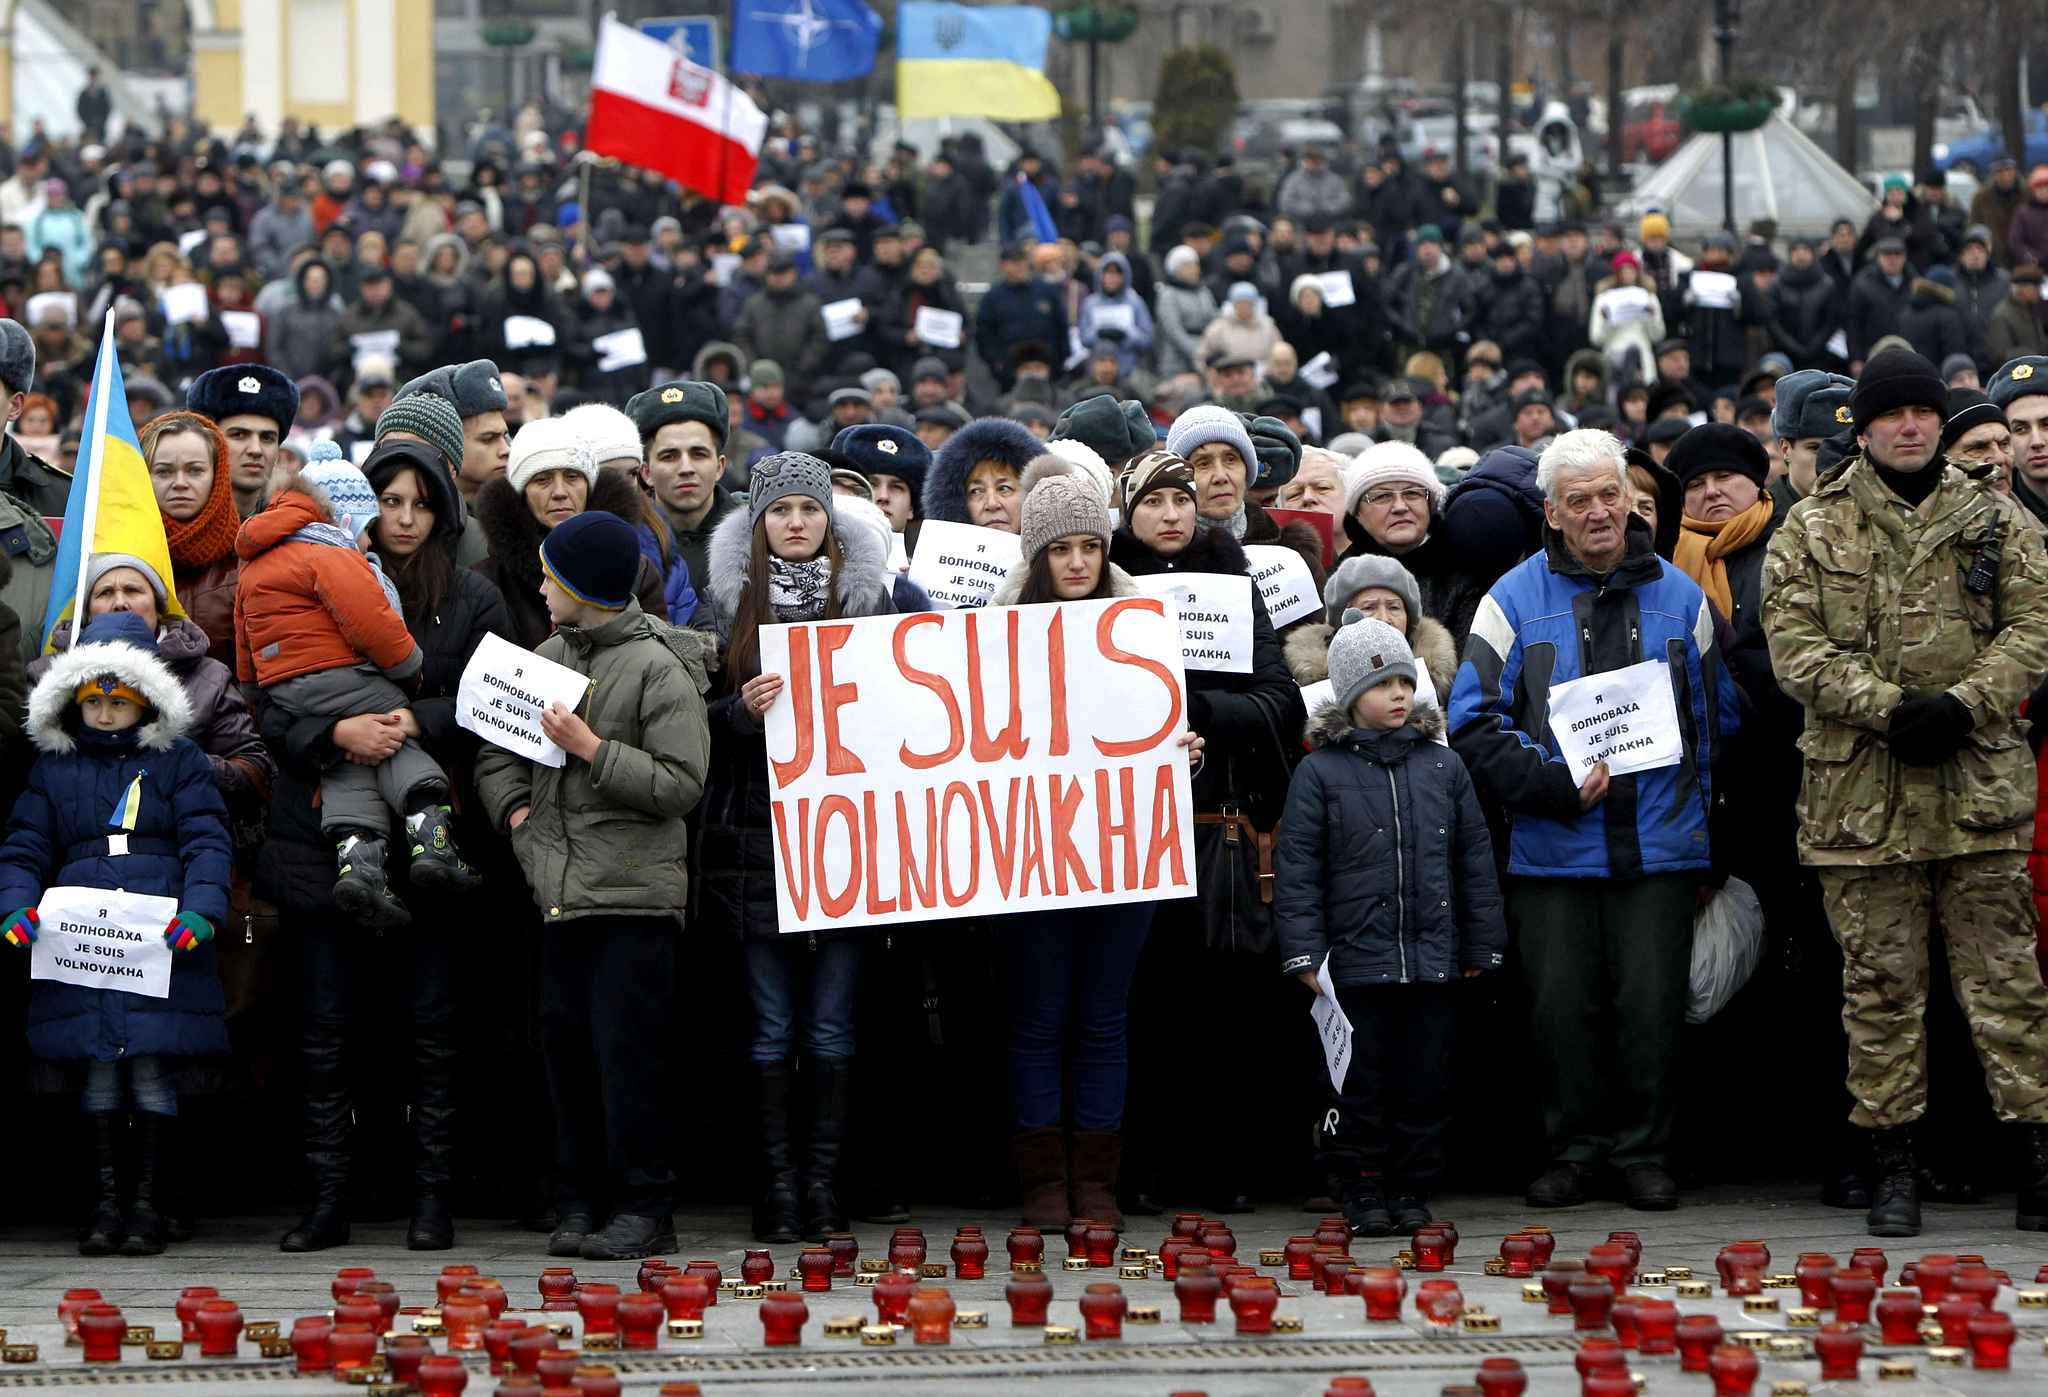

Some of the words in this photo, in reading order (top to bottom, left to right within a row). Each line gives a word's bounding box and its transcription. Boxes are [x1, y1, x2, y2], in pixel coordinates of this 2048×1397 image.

[977, 545, 985, 553] Я
[939, 555, 1008, 578] ВОЛНОВАХ
[950, 576, 964, 586] JE
[968, 578, 995, 593] SUIS
[1261, 584, 1280, 598] UIS
[1188, 594, 1196, 603] Я
[1179, 611, 1229, 623] НОВАХА
[1186, 630, 1214, 640] SUIS
[1182, 648, 1231, 660] OVAKHA
[514, 668, 523, 678] Я
[483, 673, 545, 709] ВОЛНОВАХА
[770, 624, 866, 789] JE
[892, 598, 1182, 769] SUIS
[1595, 694, 1603, 704] Я
[489, 697, 502, 709] JE
[506, 703, 531, 721] SUIS
[1571, 702, 1640, 732] ВОЛНОВАХА
[472, 707, 542, 746] VOLNOVAKHA
[1588, 733, 1602, 745] JE
[1604, 723, 1629, 739] SUIS
[772, 764, 1189, 921] VOLNOVAKHA
[98, 908, 107, 918] Я
[60, 922, 143, 943] ВОЛНОВАХА
[74, 943, 90, 953] JE
[94, 946, 125, 958] SUIS
[54, 956, 144, 979] VOLNOVAKHA
